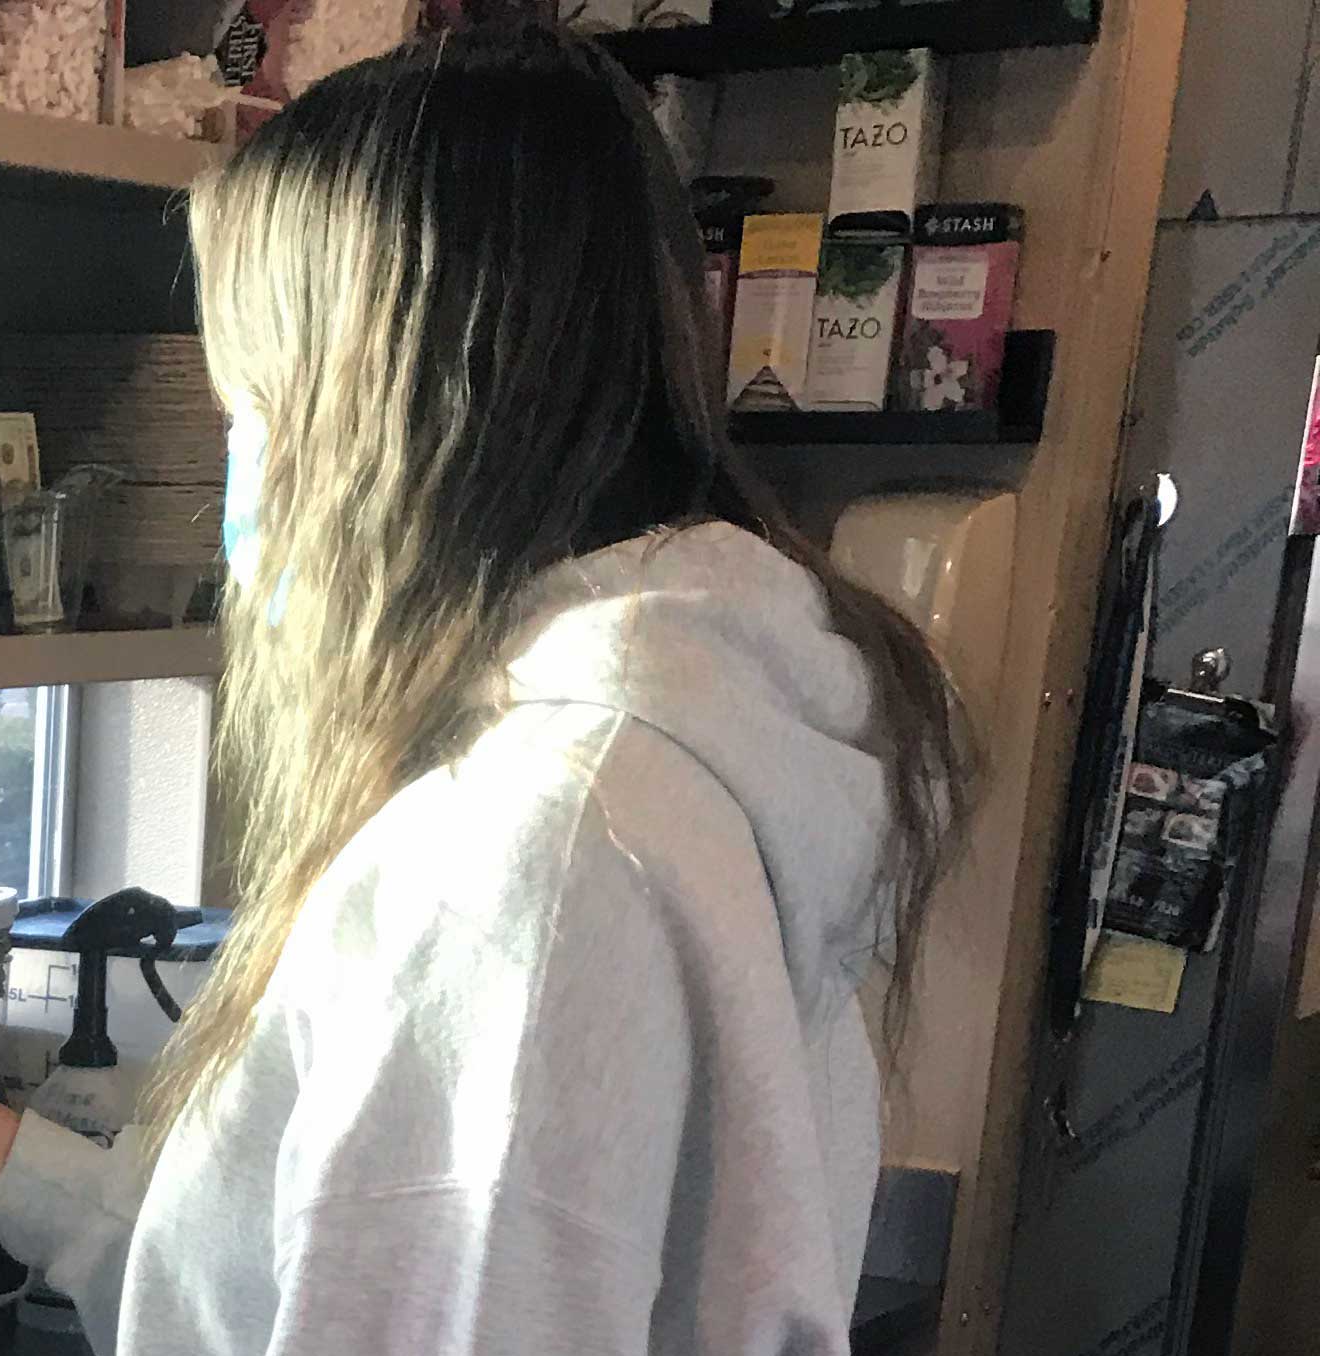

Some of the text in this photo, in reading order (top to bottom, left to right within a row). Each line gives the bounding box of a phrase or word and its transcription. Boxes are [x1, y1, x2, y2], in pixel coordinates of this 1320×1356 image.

[840, 121, 908, 149] TAZO
[942, 216, 996, 233] STASH
[817, 316, 882, 339] TAZO
